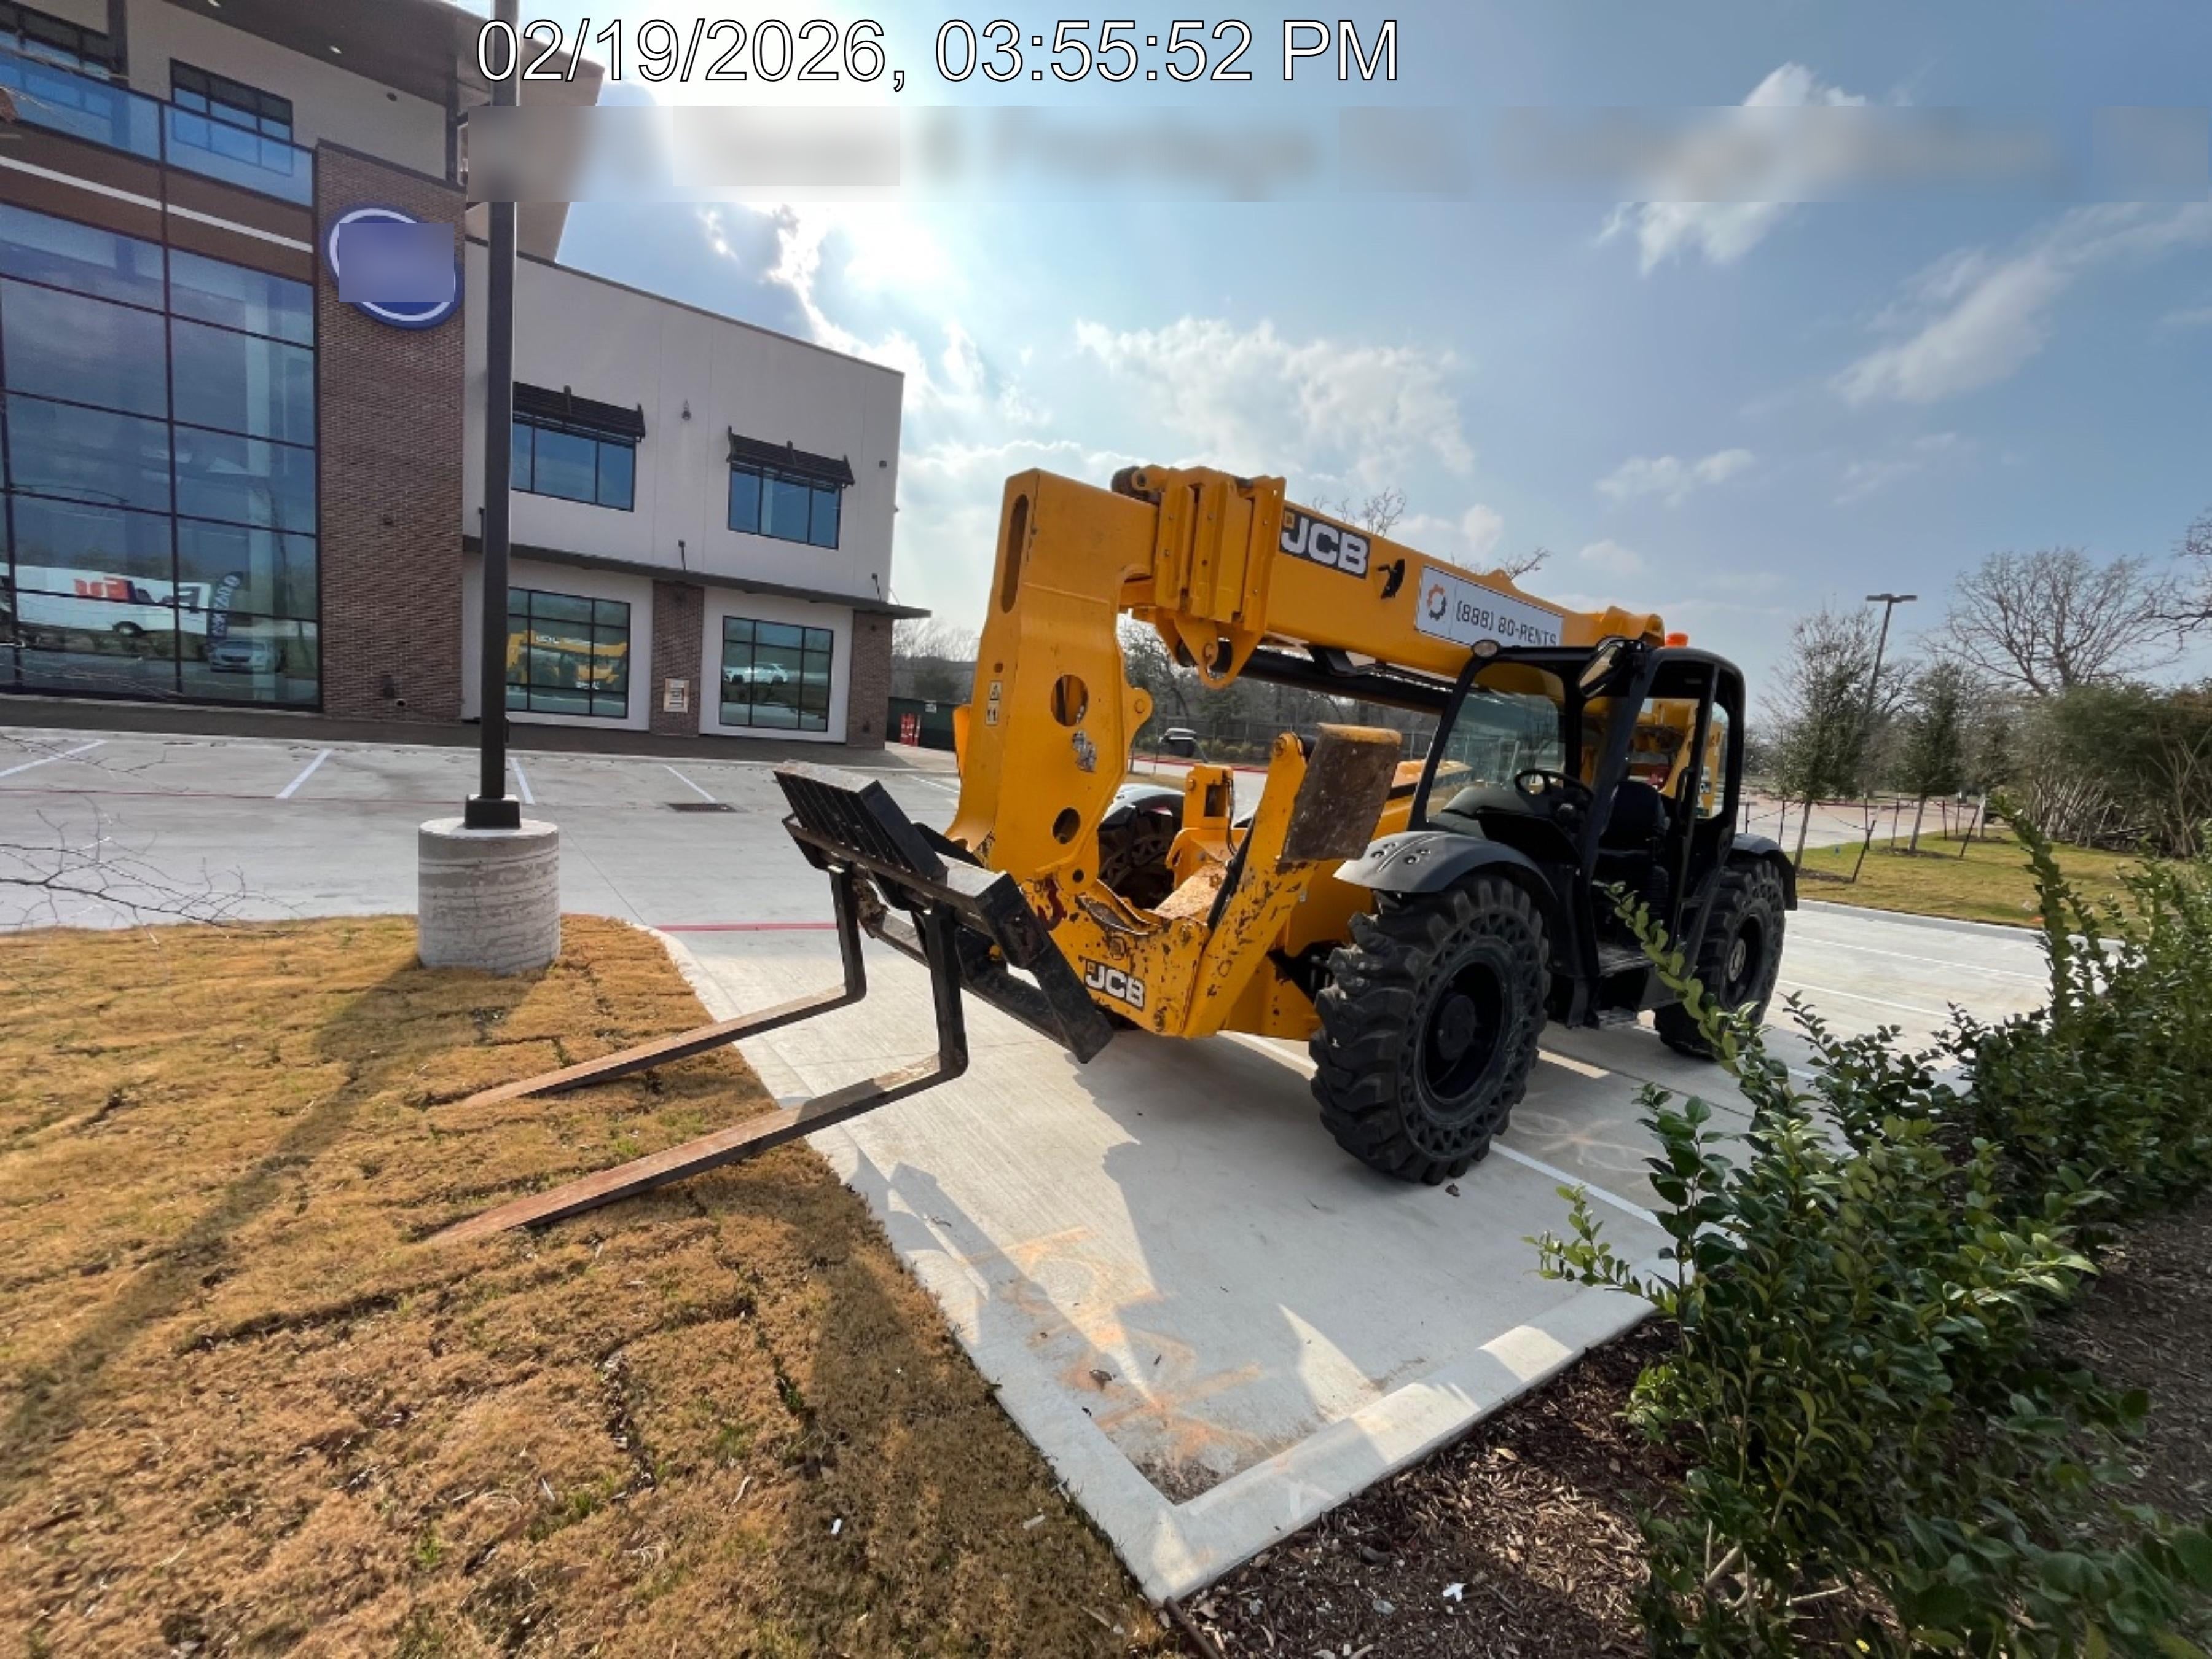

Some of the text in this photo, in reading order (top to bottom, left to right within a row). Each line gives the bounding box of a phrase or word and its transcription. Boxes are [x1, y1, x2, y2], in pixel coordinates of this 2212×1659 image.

[1281, 517, 1368, 574] JCB
[1456, 600, 1556, 646] (888) 80-RENTS
[1085, 965, 1145, 1009] JCB
